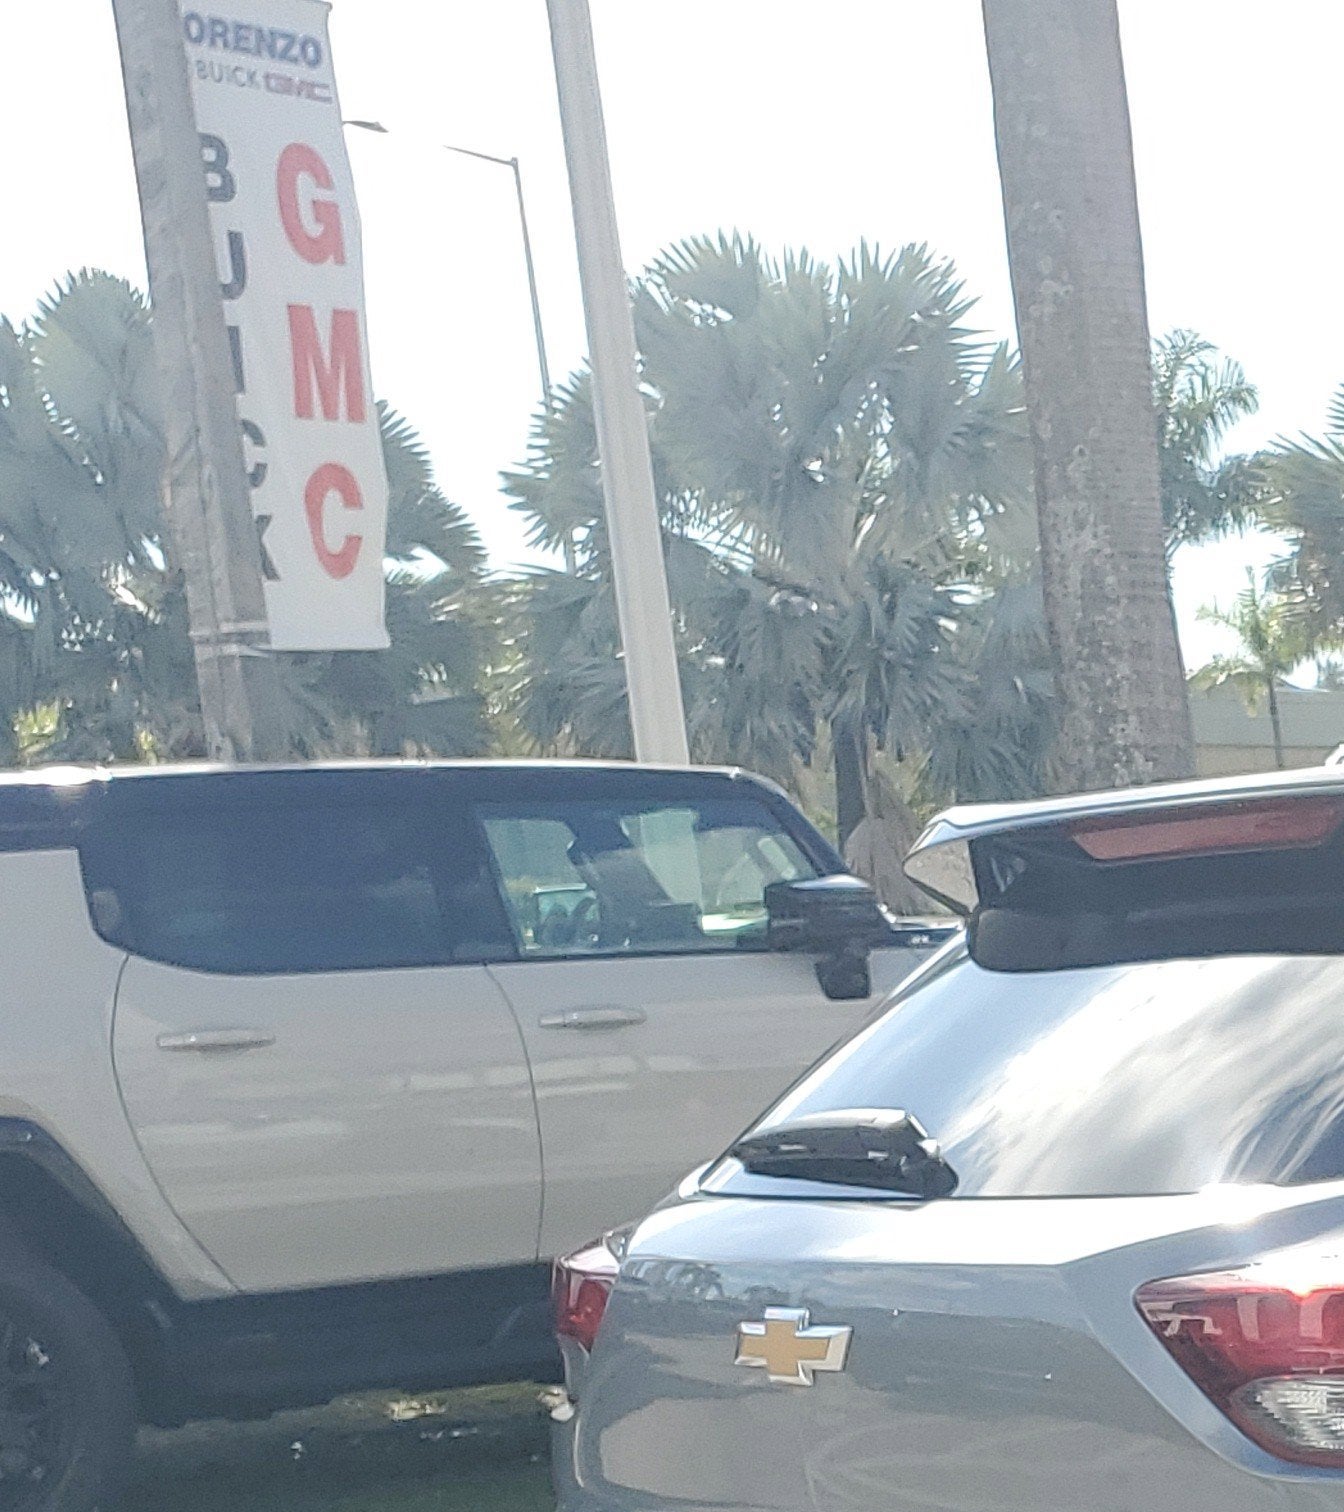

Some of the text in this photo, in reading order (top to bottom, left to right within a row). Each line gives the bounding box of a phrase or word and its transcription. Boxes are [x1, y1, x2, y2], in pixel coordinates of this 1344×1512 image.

[184, 12, 322, 68] ORENZO
[197, 60, 260, 90] BUICK
[276, 142, 366, 579] GMC
